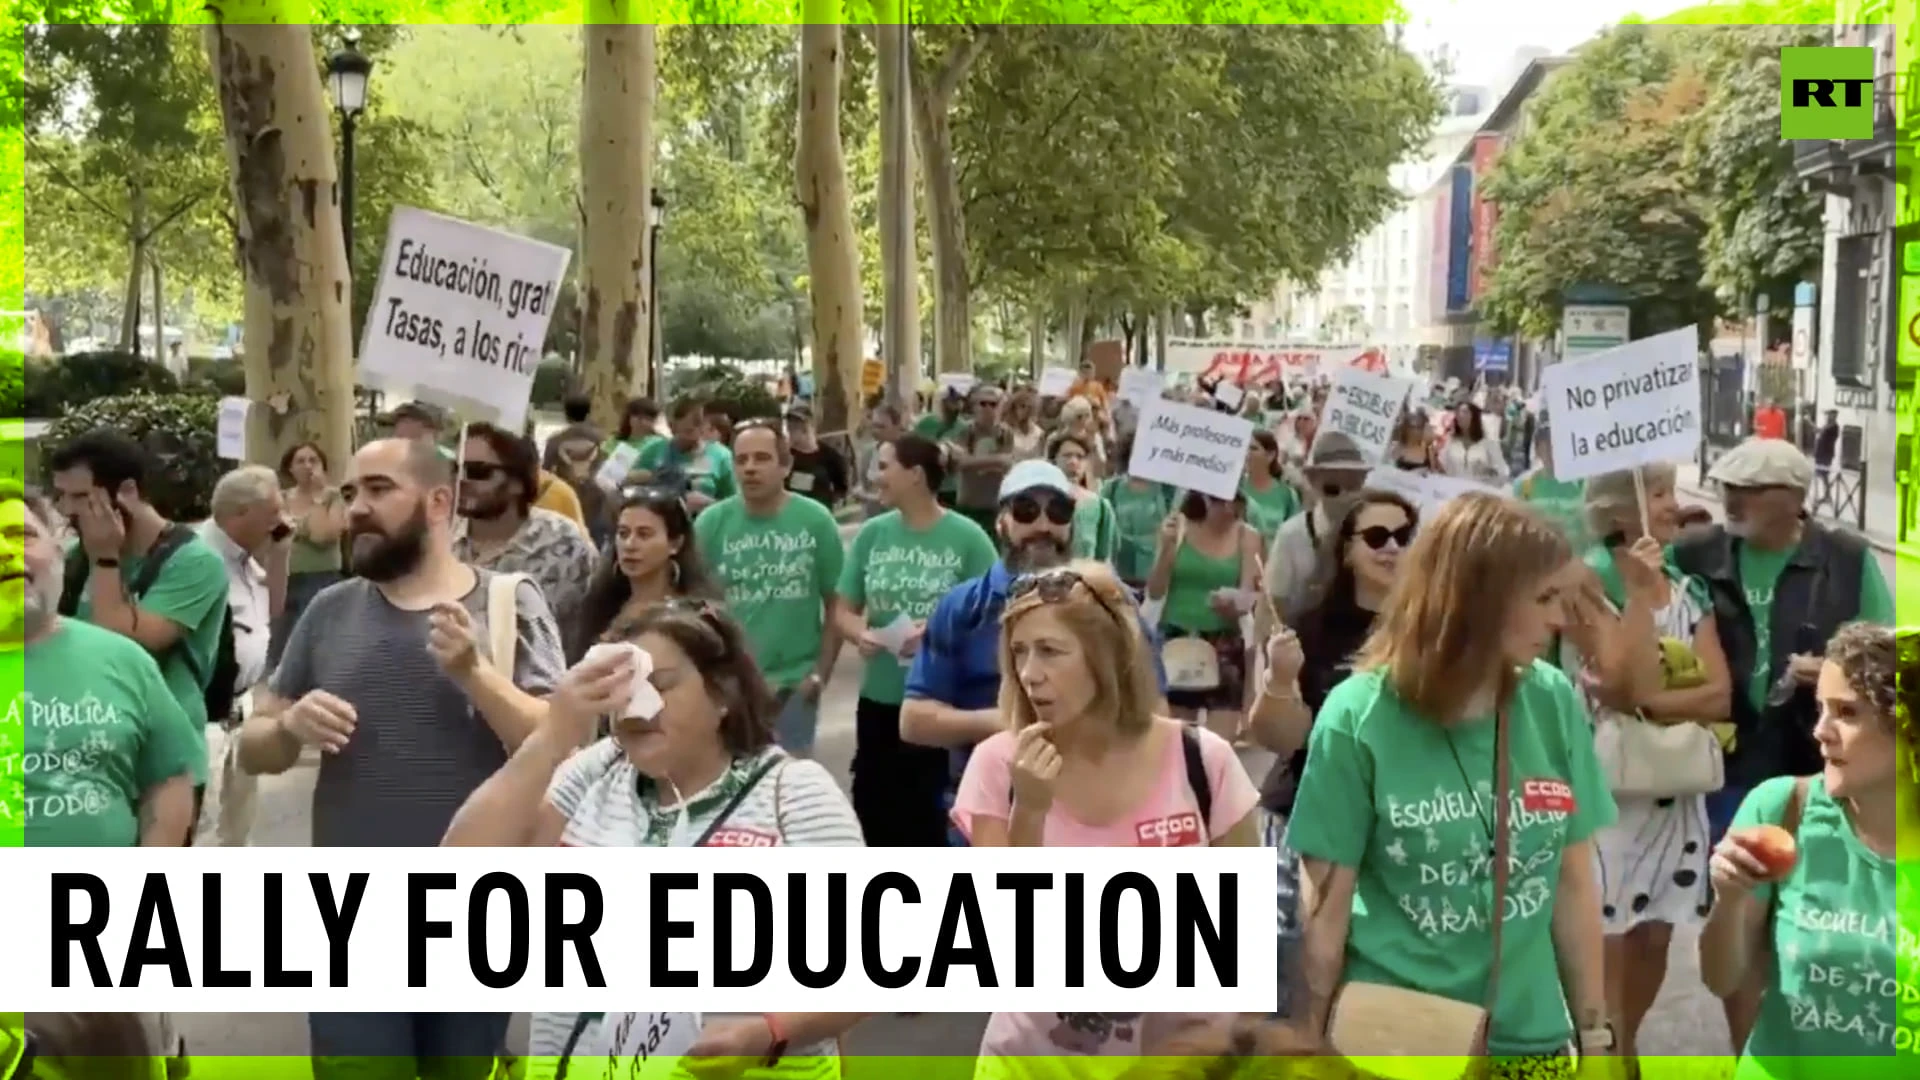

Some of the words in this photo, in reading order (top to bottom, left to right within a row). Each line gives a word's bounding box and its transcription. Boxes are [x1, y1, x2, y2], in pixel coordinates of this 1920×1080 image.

[395, 238, 503, 310] Educación,
[385, 297, 447, 358] Tasas,
[453, 326, 466, 356] a
[471, 320, 500, 366] los
[1566, 386, 1597, 412] No
[1148, 446, 1159, 462] y
[1160, 446, 1184, 464] más
[1571, 431, 1589, 460] la
[30, 696, 121, 728] PÚBLICA
[1420, 861, 1456, 885] DE
[1798, 907, 1890, 945] ESCUELA
[1808, 962, 1845, 987] DE
[1790, 1002, 1865, 1037] PARA
